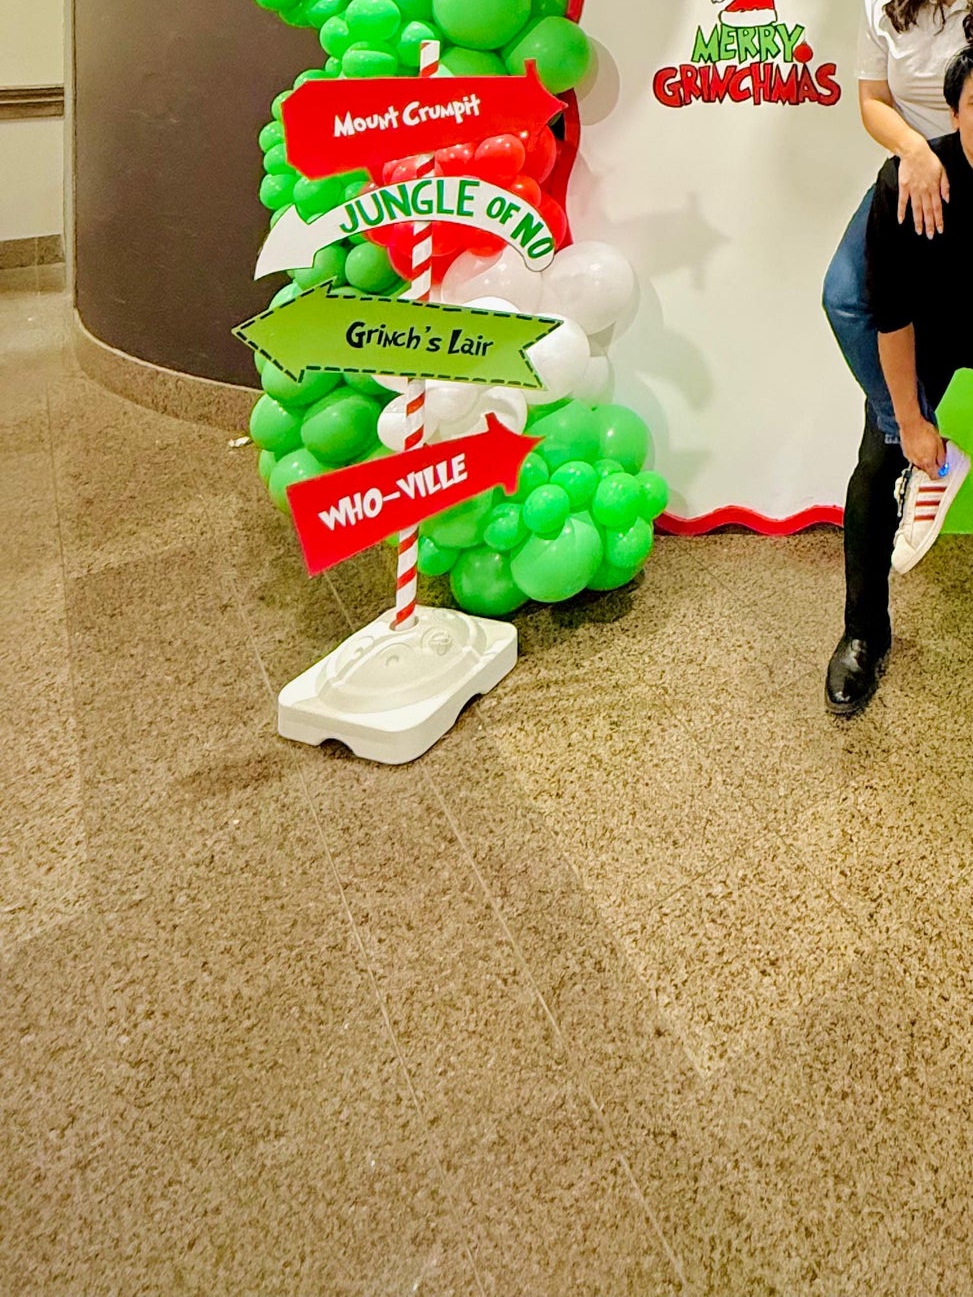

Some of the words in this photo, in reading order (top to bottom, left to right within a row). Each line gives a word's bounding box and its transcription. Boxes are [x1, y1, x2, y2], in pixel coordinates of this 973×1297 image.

[691, 22, 805, 64] MERRY
[653, 62, 841, 108] GRINCHMAS
[333, 106, 398, 138] Mount
[402, 93, 481, 126] Crumpit
[339, 179, 481, 234] JUNGLE
[486, 196, 515, 225] OF
[510, 207, 555, 260] NO
[345, 320, 441, 351] Grinch's
[447, 329, 494, 357] Lair
[318, 453, 469, 531] WHO-VILLE
